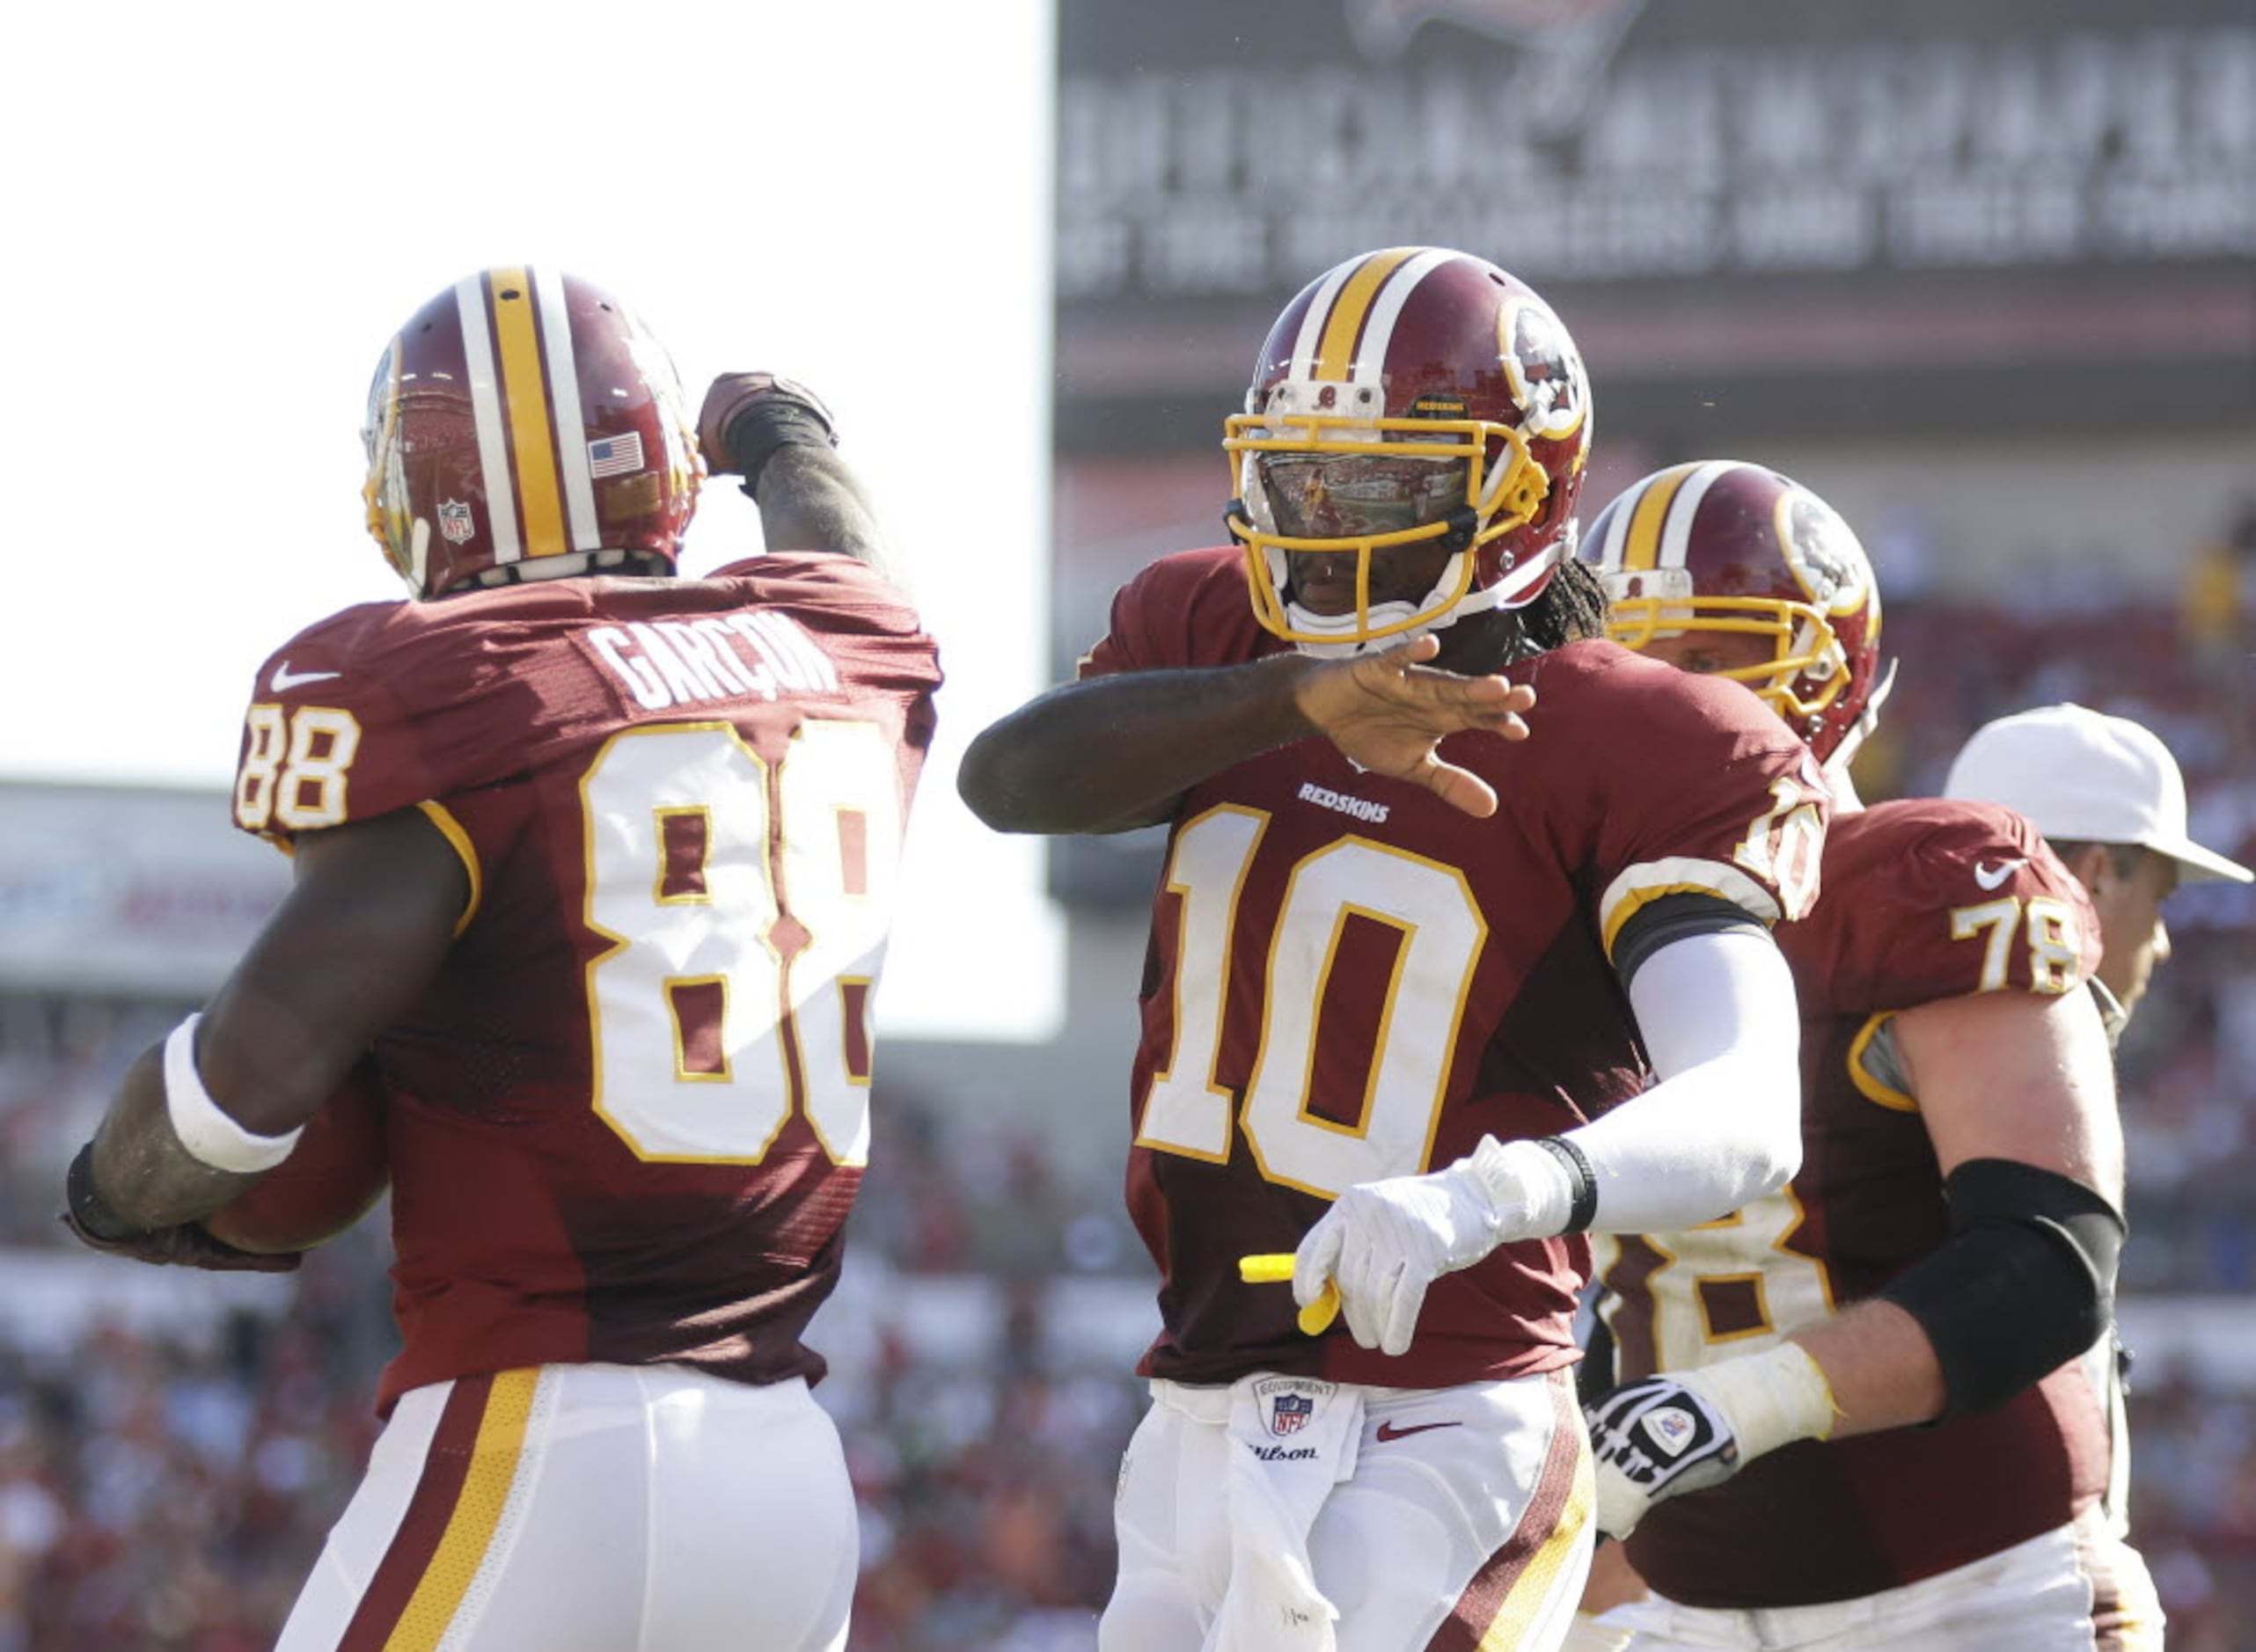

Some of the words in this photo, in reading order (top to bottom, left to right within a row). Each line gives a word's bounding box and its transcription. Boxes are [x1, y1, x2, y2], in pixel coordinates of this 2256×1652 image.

[237, 703, 363, 830] 88
[1298, 781, 1390, 823] REDSKINS
[1733, 776, 1823, 922] 10
[578, 720, 902, 1166] 88
[1951, 895, 2082, 995] 78
[1133, 800, 1490, 1202] 10
[1259, 1379, 1332, 1396] EQUIPMENT
[1277, 1413, 1308, 1435] NFL
